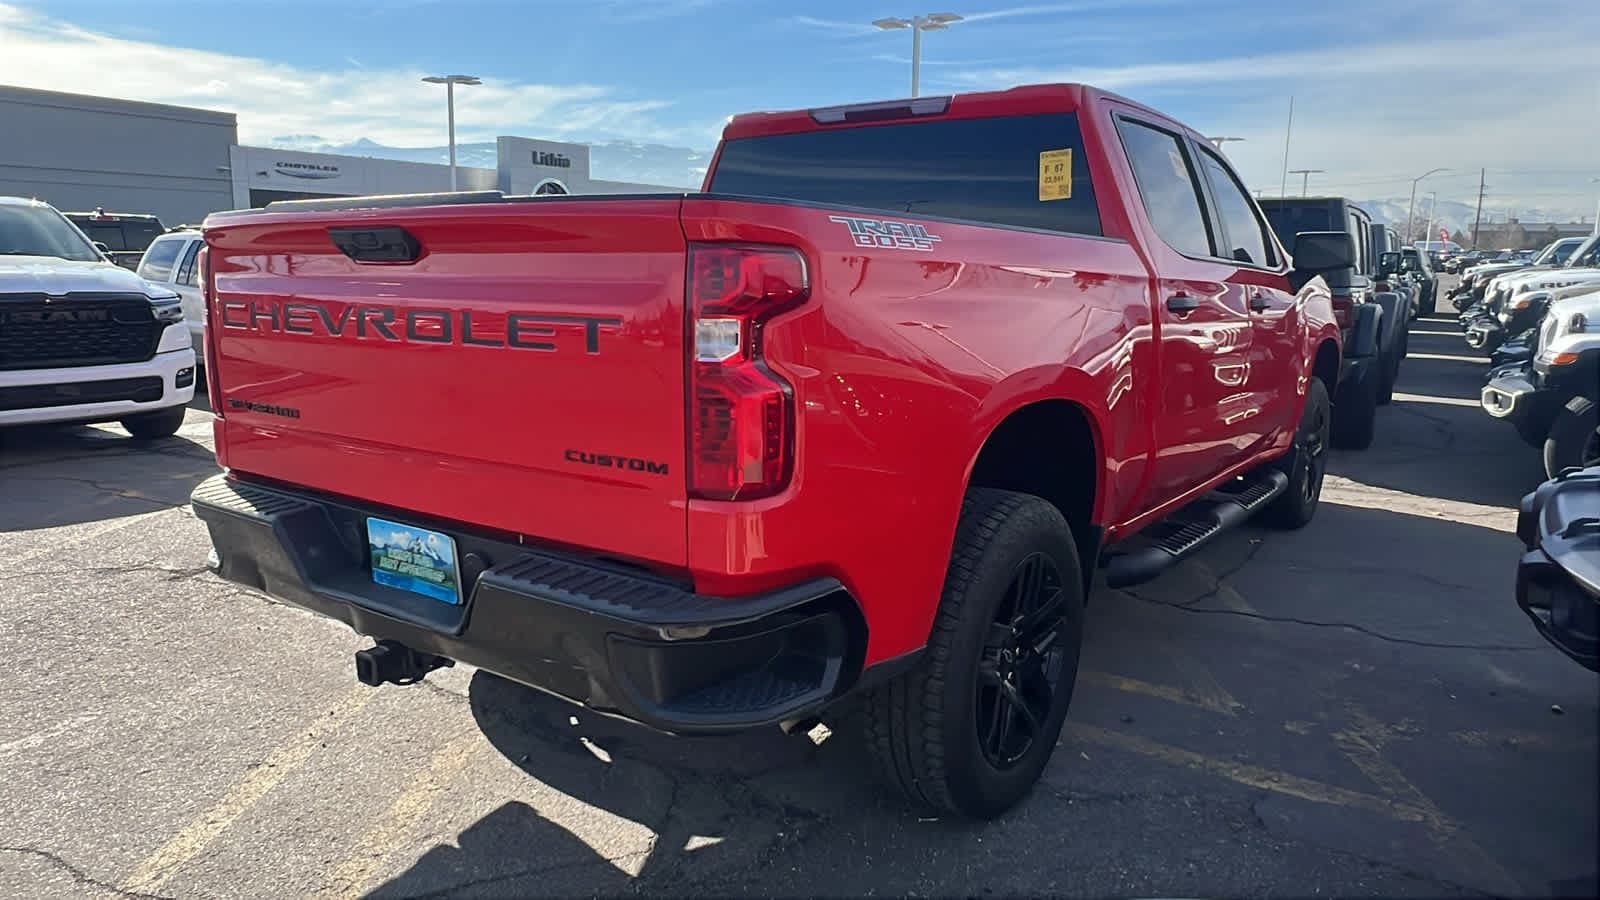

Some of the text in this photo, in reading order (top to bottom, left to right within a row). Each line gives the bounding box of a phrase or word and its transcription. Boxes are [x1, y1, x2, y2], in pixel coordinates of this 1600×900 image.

[532, 150, 570, 168] Lithia
[828, 215, 943, 242] TRAIL
[853, 233, 934, 251] BOSS
[221, 299, 624, 356] CHEVROLET
[564, 449, 669, 475] CUSTOM
